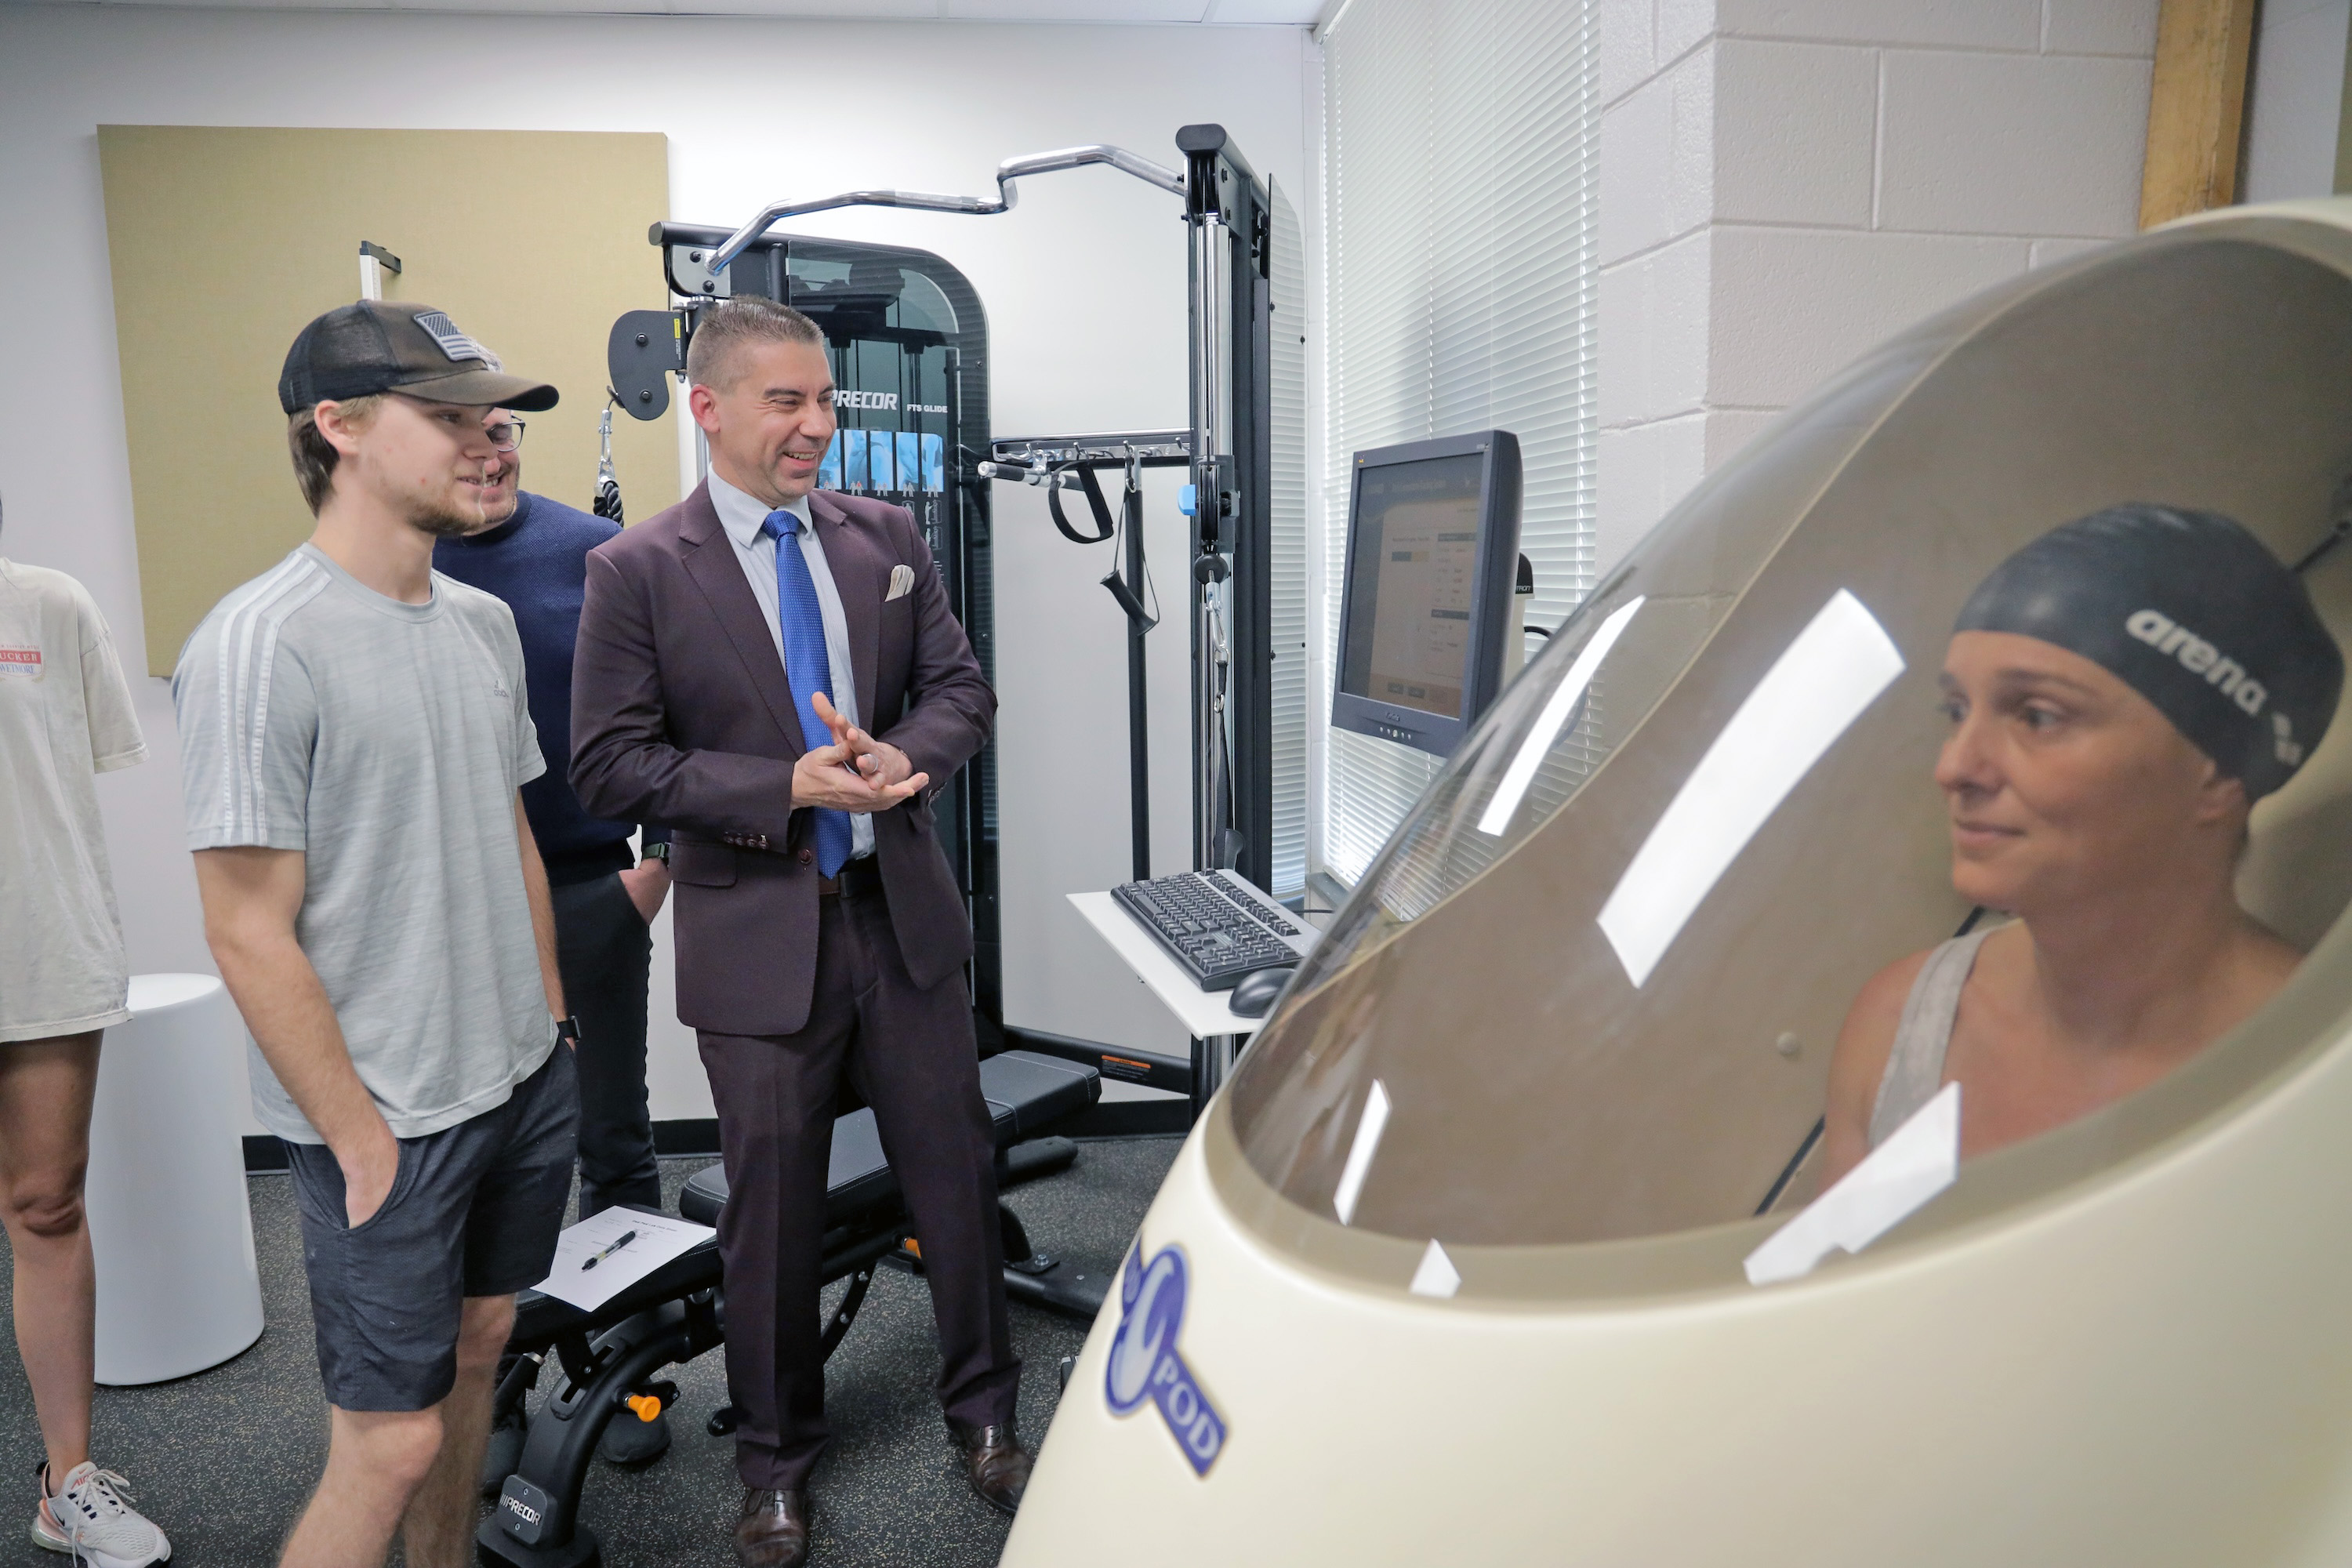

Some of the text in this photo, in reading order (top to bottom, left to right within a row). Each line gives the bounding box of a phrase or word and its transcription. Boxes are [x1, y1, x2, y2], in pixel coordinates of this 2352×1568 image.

[924, 405, 948, 413] GLIDE
[2125, 609, 2268, 717] arena
[1153, 1353, 1220, 1459] POD
[504, 1496, 541, 1526] PRECOR
